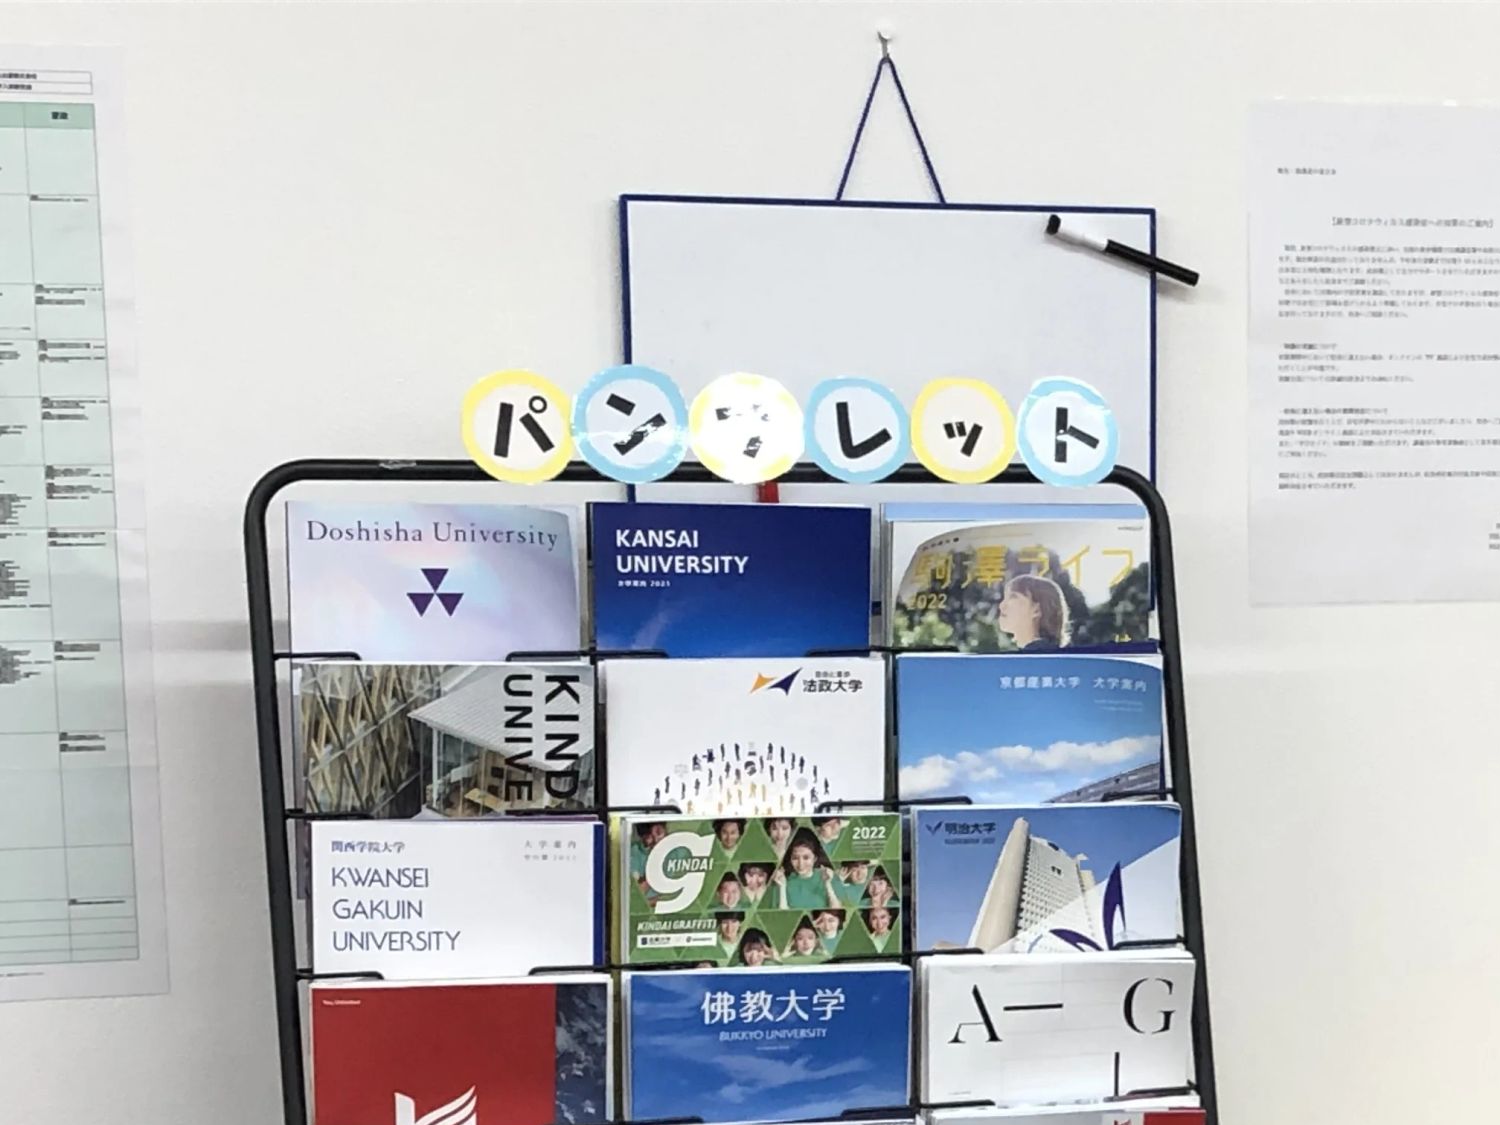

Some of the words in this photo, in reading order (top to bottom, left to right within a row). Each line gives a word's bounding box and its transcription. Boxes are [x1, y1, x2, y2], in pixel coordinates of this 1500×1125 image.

[307, 519, 423, 543] Doshisha
[433, 521, 559, 551] University
[616, 529, 699, 548] KANSAI
[616, 555, 749, 574] UNIVERSITY
[906, 593, 948, 609] 2022
[802, 679, 863, 693] 法政大学
[1093, 677, 1147, 692] 大学案内
[852, 826, 887, 839] 2022
[944, 822, 997, 834] 明治大学
[667, 858, 714, 872] KINDAI
[331, 867, 430, 889] KWANSEI
[332, 898, 424, 920] GAKUIN
[637, 920, 672, 931] KINDAI
[333, 929, 462, 952] UNIVERSITY
[701, 988, 846, 1025] 佛教大学
[719, 1030, 764, 1042] BUKKYO
[765, 1028, 827, 1040] UNIVERSITY
